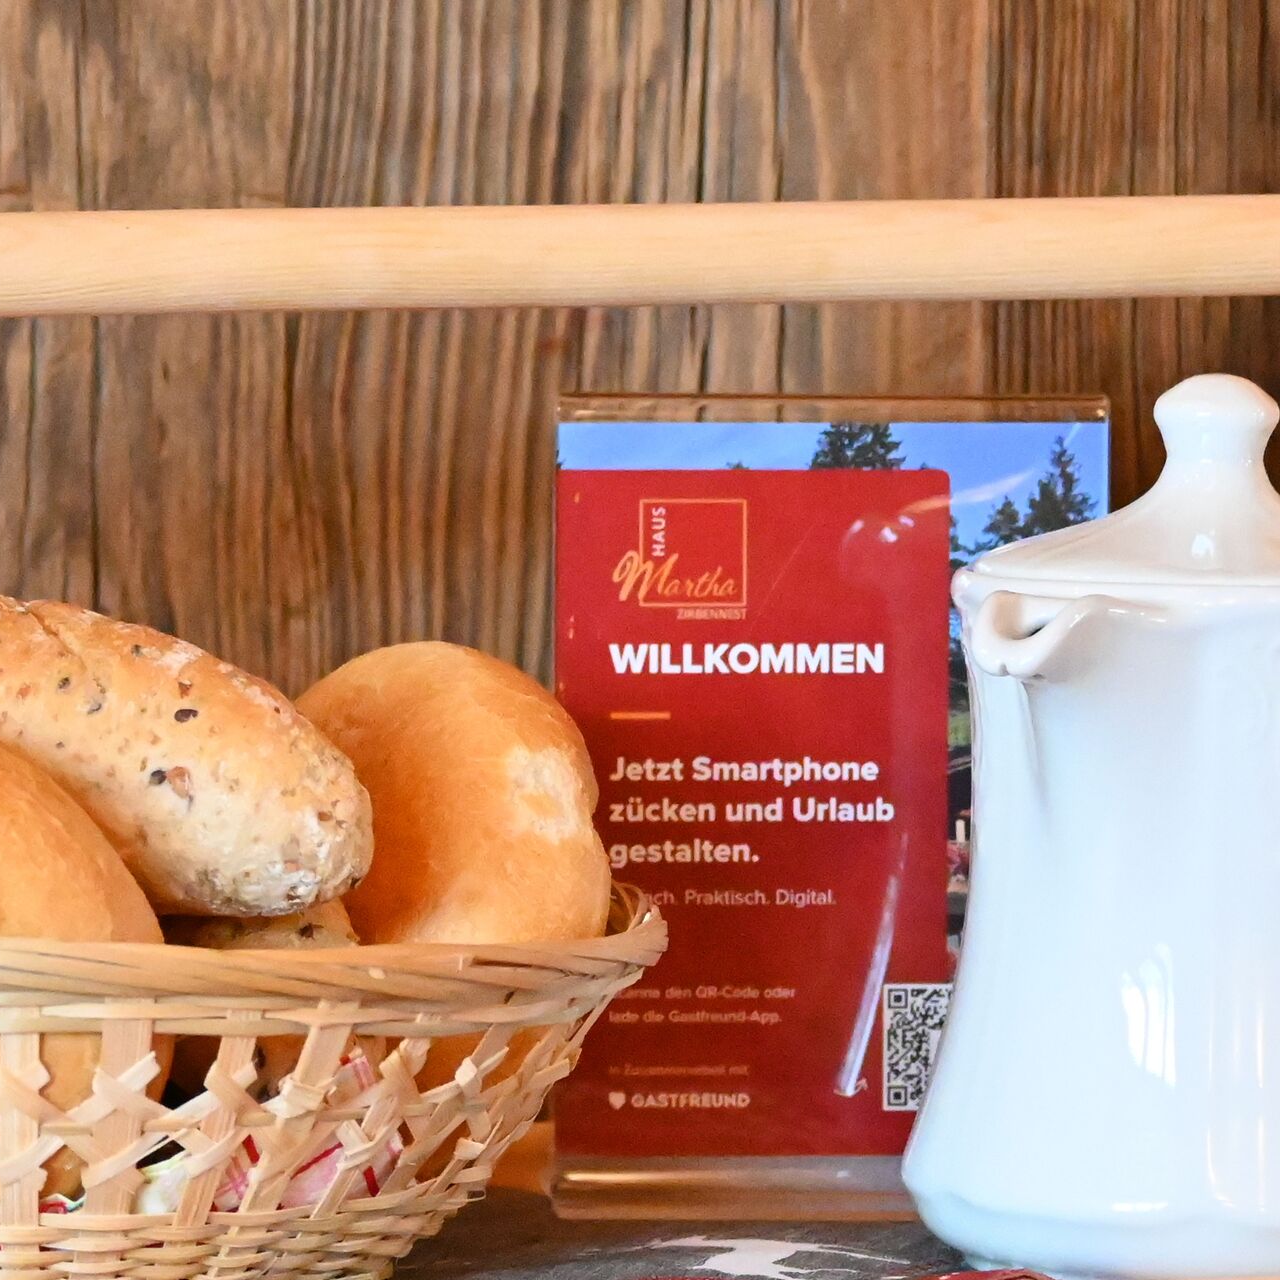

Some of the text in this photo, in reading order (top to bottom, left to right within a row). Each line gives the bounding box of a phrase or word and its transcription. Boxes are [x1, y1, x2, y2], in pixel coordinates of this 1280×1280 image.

[651, 506, 666, 557] HAUS
[613, 550, 738, 601] Martha
[608, 643, 885, 674] WILLKOMMEN
[609, 756, 880, 787] Jetzt Smartphone
[609, 797, 895, 823] zücken und Urlaub
[610, 838, 760, 868] gestalten.
[685, 889, 770, 905] Praktisch.
[776, 889, 836, 908] Digital.
[619, 985, 796, 1000] canne den QR-Code oder
[608, 1010, 783, 1025] lade die Gastfreund-App.
[631, 1092, 751, 1108] GASTFREUND
